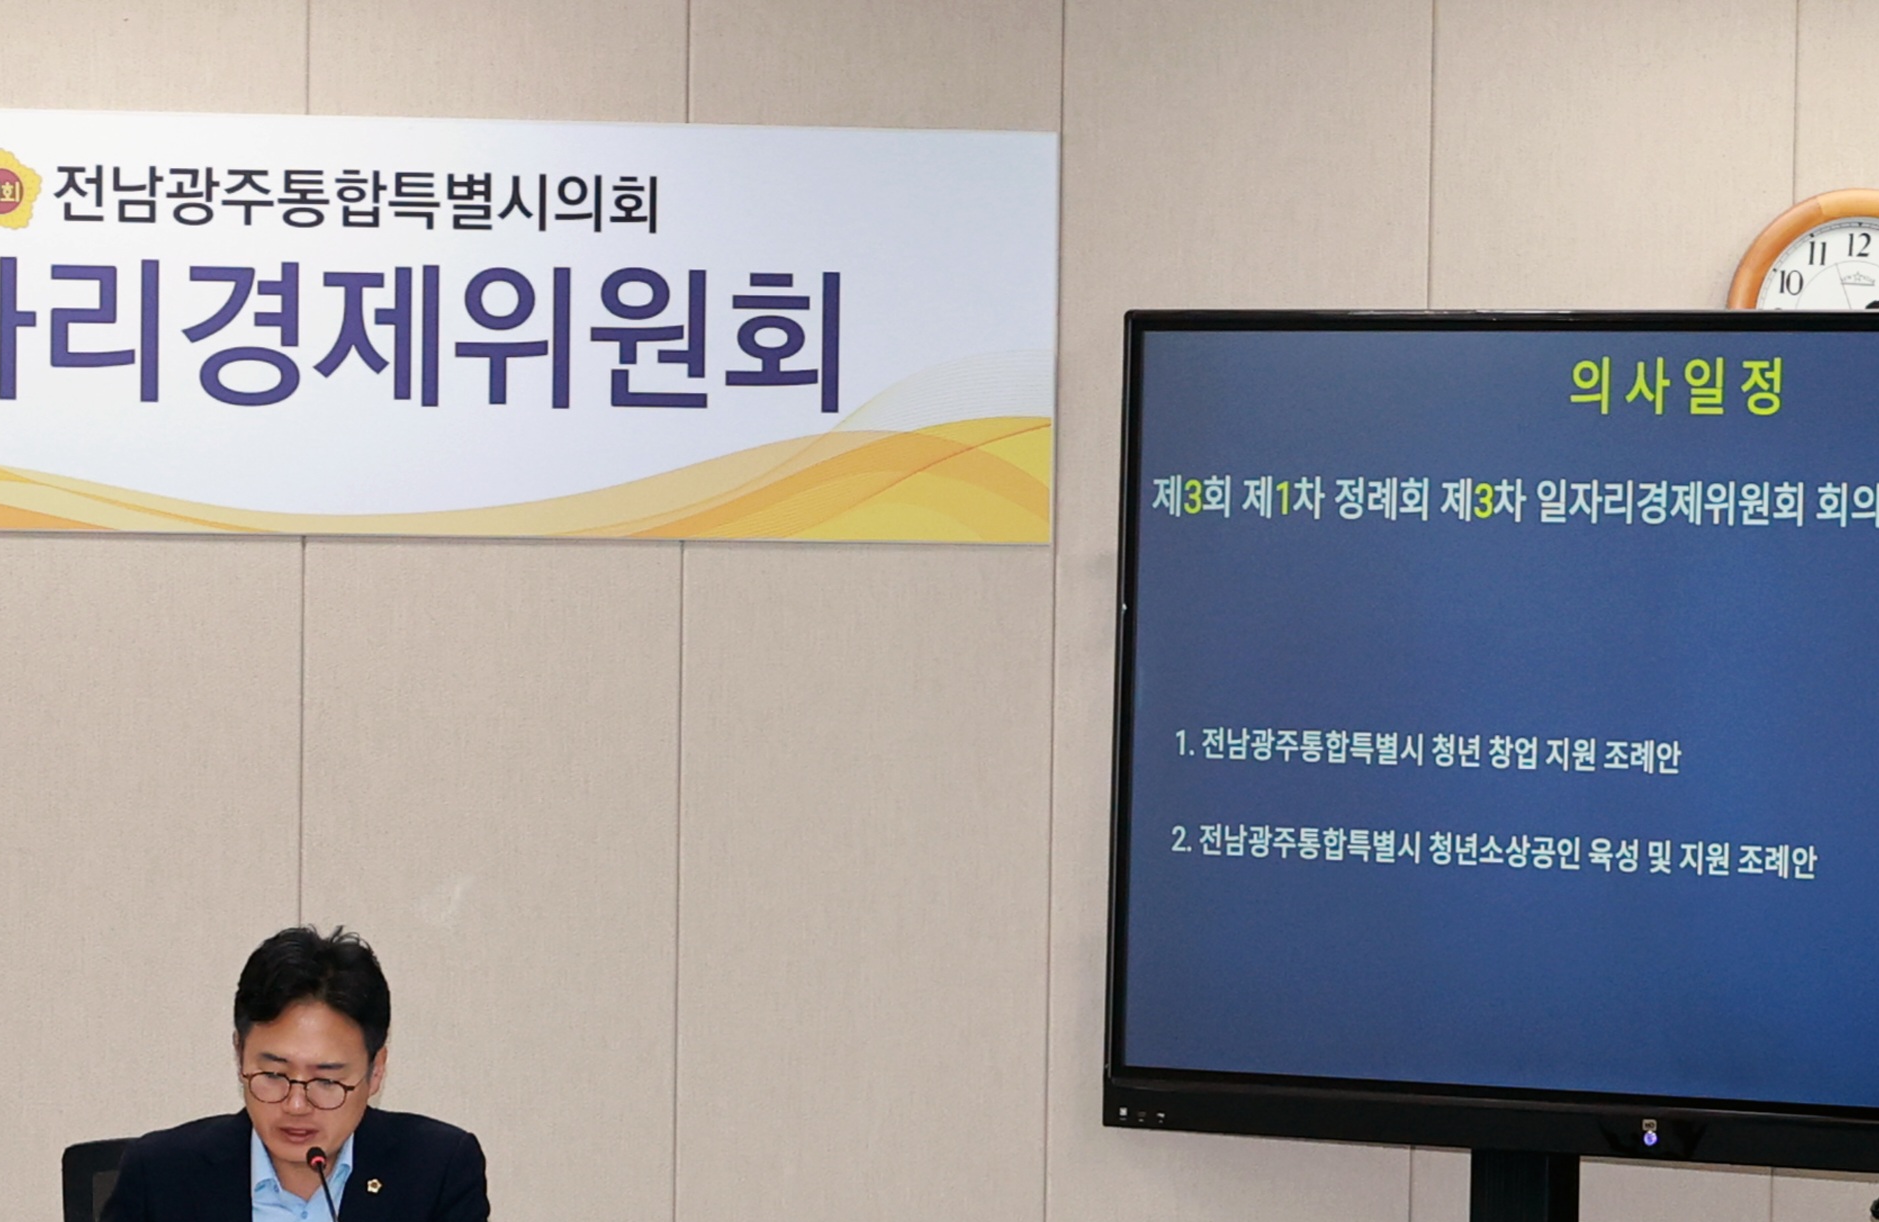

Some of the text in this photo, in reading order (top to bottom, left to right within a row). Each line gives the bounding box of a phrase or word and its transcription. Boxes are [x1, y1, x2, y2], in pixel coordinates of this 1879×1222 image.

[53, 164, 659, 235] 전남광주통합특별시의회
[1807, 240, 1827, 266] 11
[1847, 232, 1872, 258] 12
[1778, 269, 1804, 296] 10
[1570, 356, 1782, 416] 의사일정
[1152, 474, 1231, 519] 제3회
[1241, 475, 1326, 520] 제1차
[1334, 476, 1429, 522] 정례회
[1440, 477, 1528, 523] 제3차
[1536, 478, 1804, 528] 일자리경제위원회
[1175, 726, 1683, 775] 1. 전남광주통합특별시 청년 창업 지원 조례안
[1171, 823, 1818, 880] 2. 전남광주통합특별시 청년소상공인 육성 및 지원 조례안
